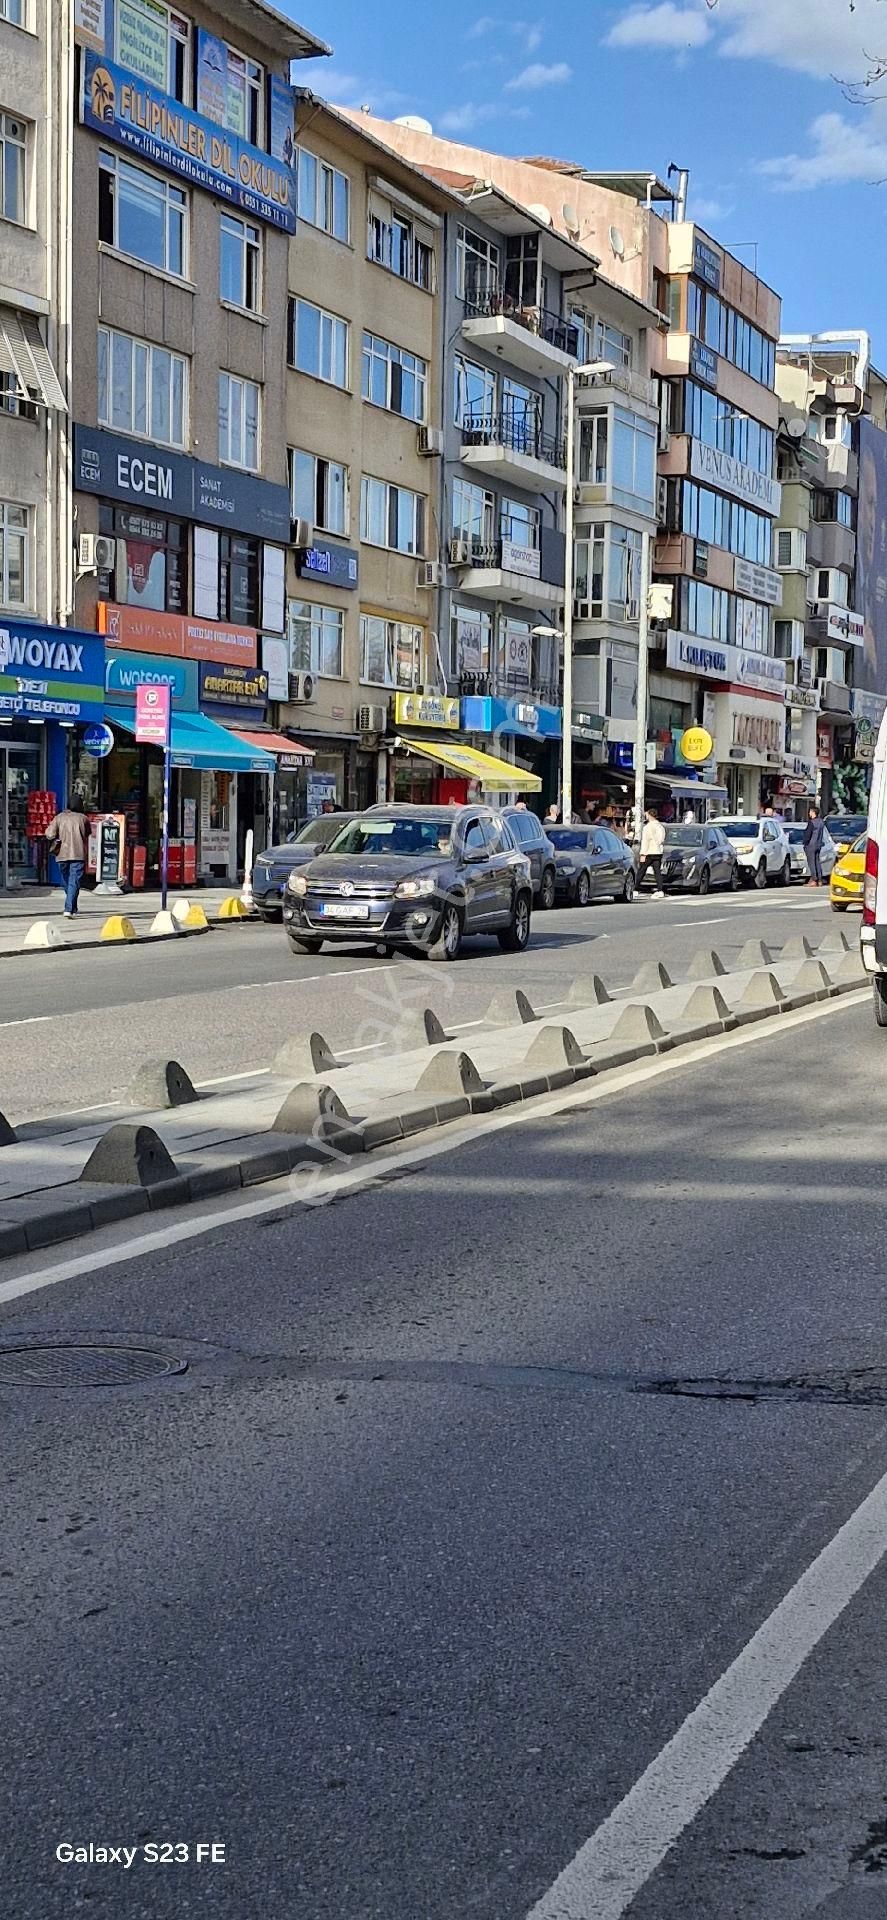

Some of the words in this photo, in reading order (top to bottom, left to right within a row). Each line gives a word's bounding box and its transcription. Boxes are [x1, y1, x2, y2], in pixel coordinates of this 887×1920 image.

[119, 128, 233, 196] www.filipinlerdilokulu.com
[120, 81, 207, 164] FİLİPİNLER
[211, 134, 236, 178] DİL
[238, 153, 289, 206] OKULU
[80, 466, 100, 481] ECEM
[118, 454, 173, 500] ECEM
[699, 443, 731, 482] VENUS
[200, 475, 221, 492] SANAT
[8, 636, 84, 672] WOYAX
